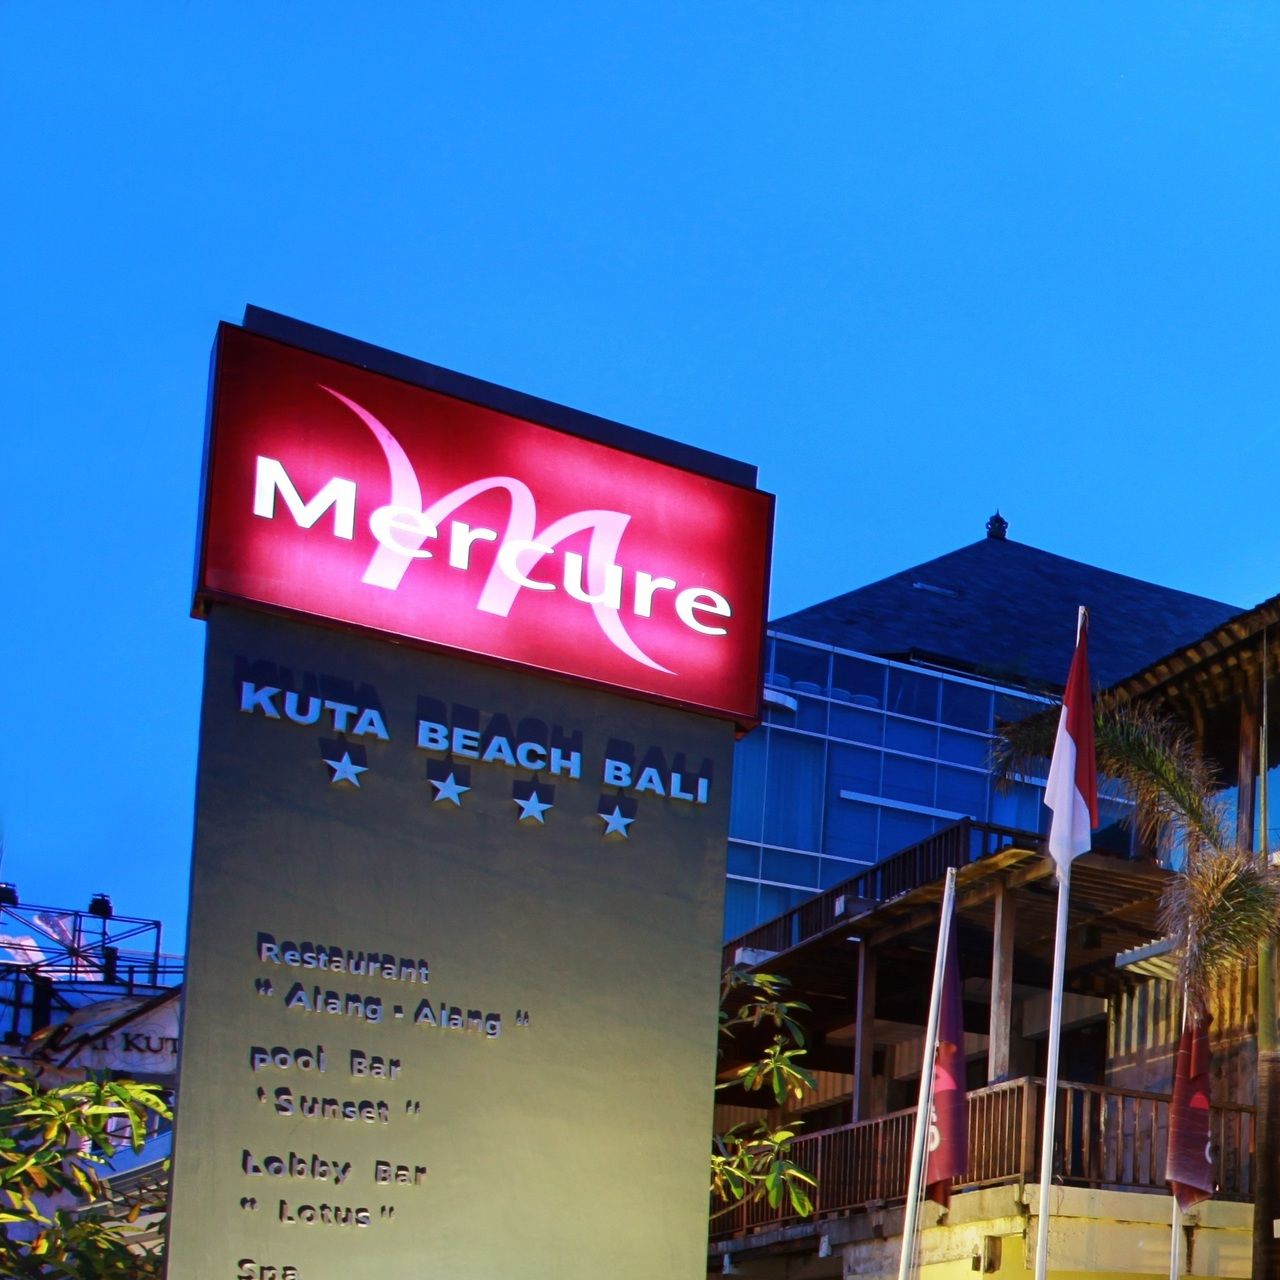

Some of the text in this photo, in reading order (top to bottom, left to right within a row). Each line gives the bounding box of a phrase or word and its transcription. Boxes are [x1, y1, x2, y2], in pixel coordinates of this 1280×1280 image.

[252, 455, 732, 637] Mercure
[239, 681, 709, 804] KUTA BEACH BALI
[258, 936, 430, 985] Restaurant
[351, 1052, 401, 1081] Bar
[243, 1150, 427, 1186] Lobby Bar
[279, 1200, 372, 1228] Lotus
